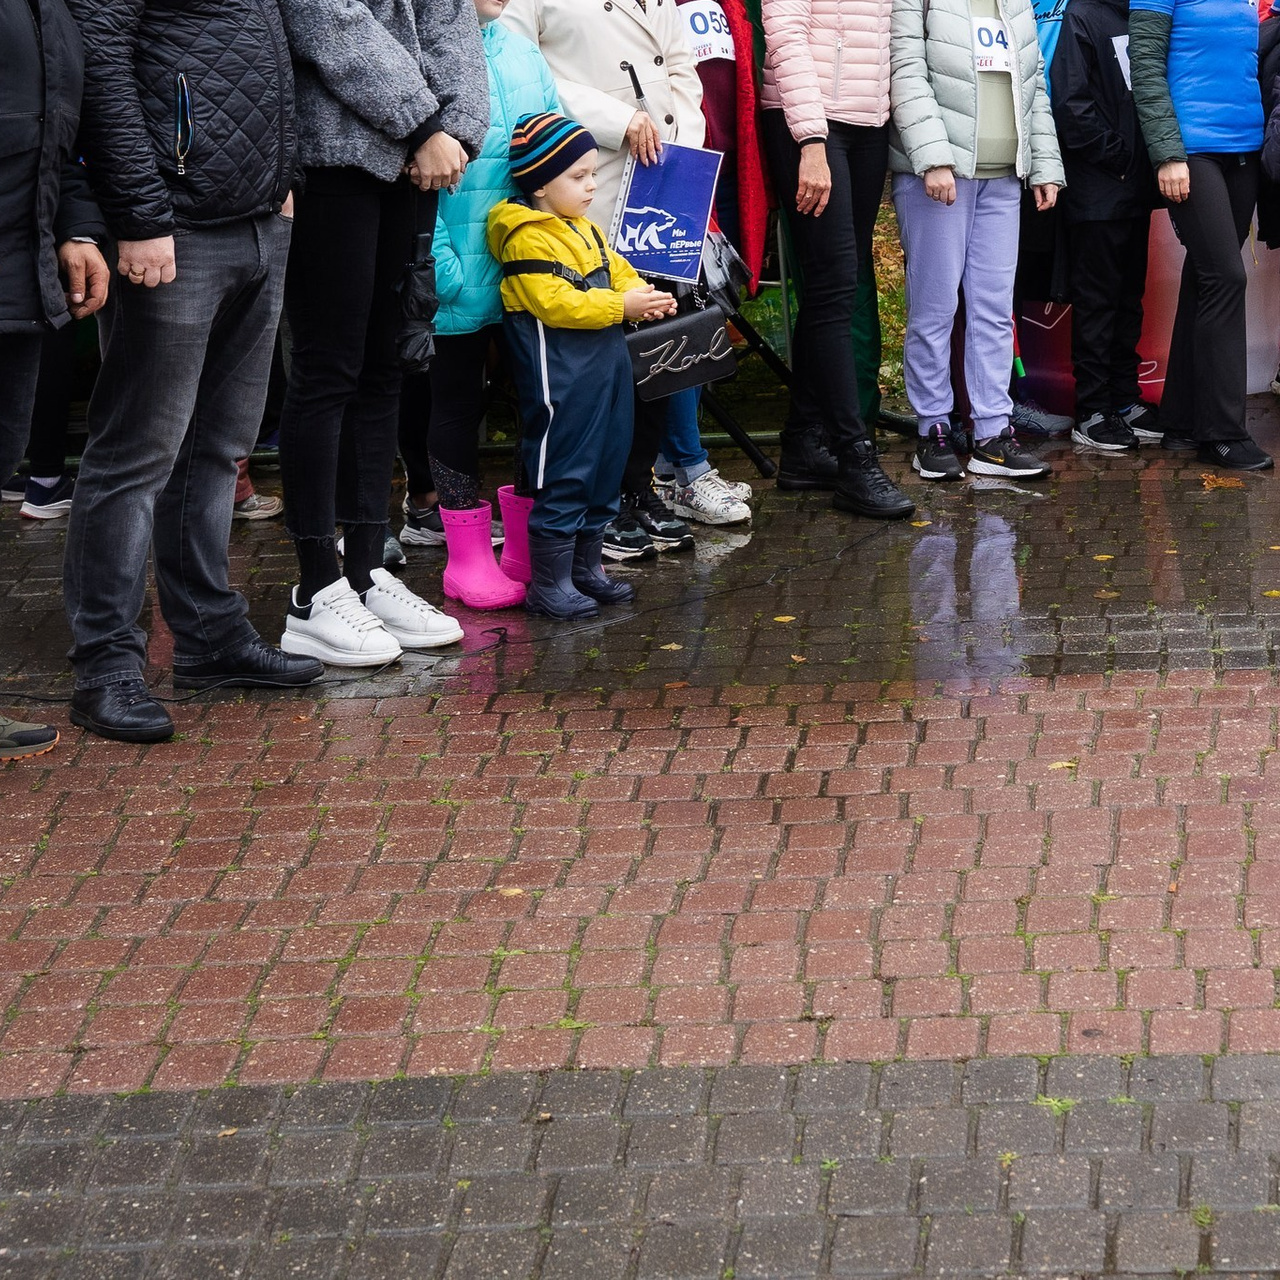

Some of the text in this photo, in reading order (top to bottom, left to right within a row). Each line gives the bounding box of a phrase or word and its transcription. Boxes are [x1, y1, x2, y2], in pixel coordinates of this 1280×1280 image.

[690, 10, 732, 36] 059
[977, 27, 1009, 49] 04
[671, 228, 687, 238] Мы
